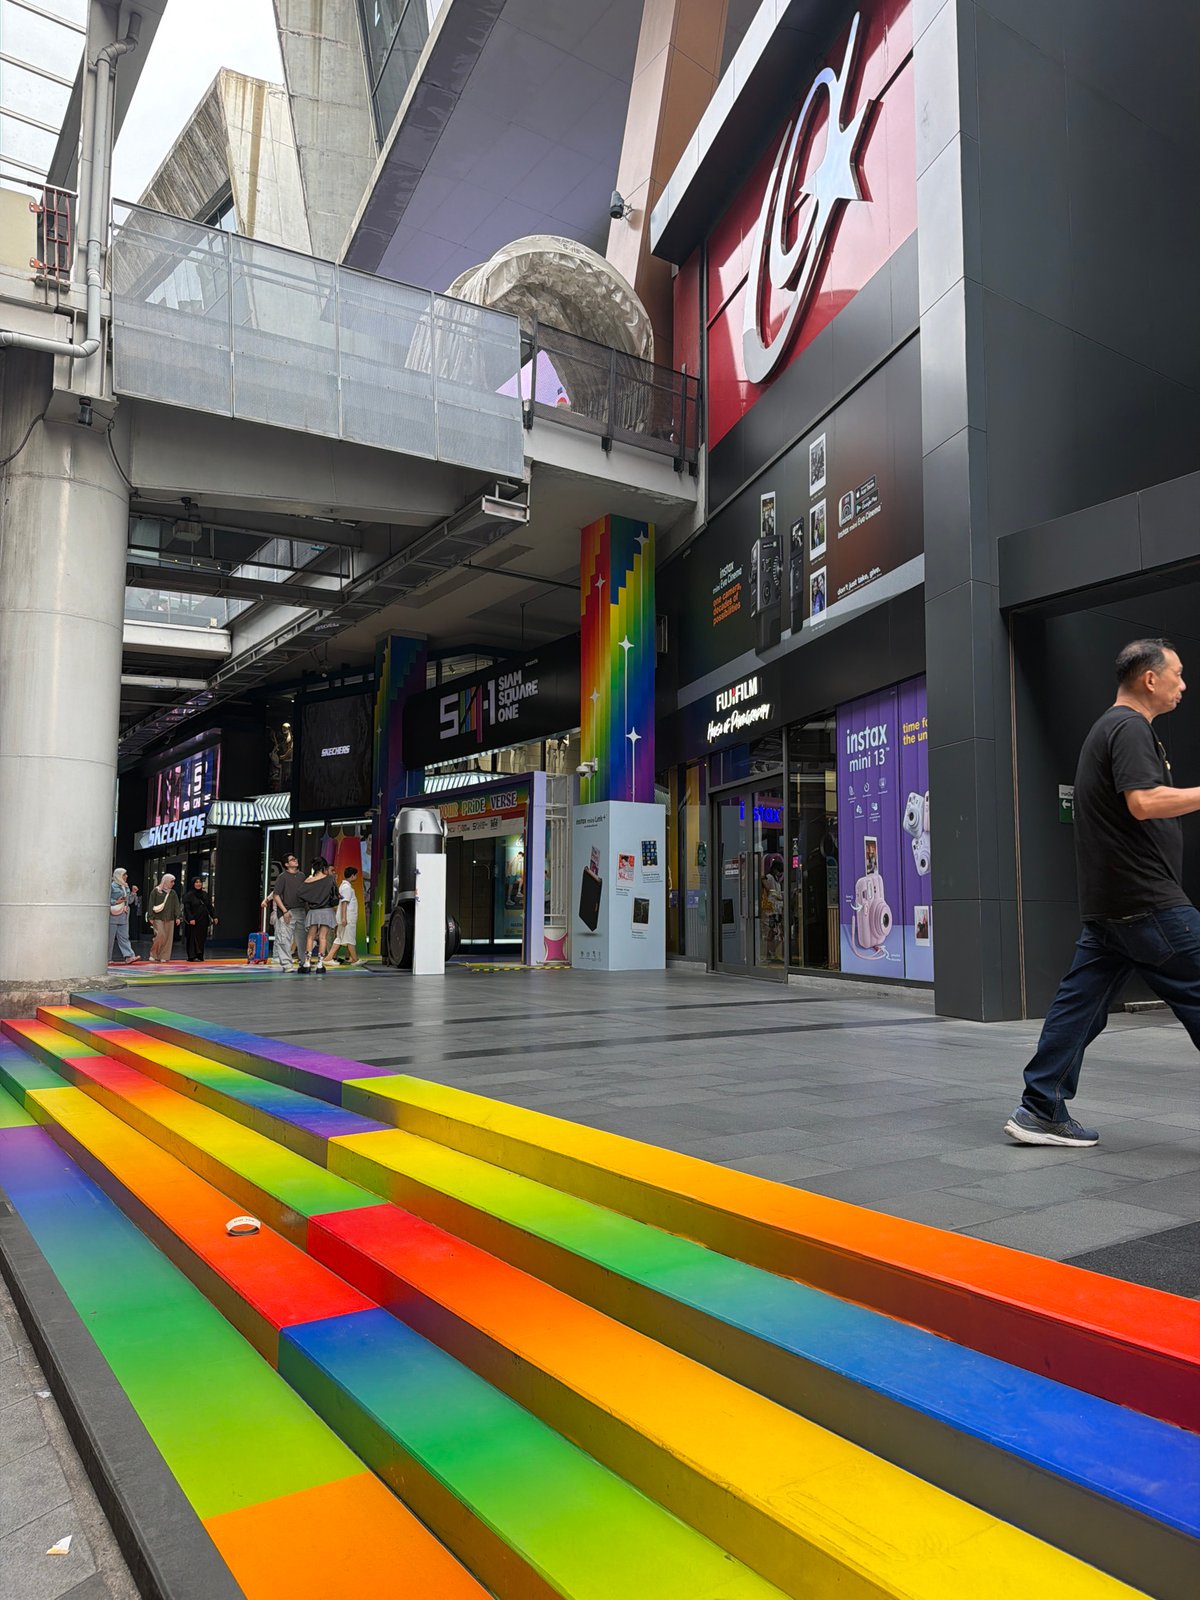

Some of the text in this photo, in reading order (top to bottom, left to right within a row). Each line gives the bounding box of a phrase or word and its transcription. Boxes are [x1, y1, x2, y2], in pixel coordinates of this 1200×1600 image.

[498, 669, 522, 691] SIAM
[498, 679, 539, 707] SQUARE
[716, 676, 758, 713] FUJIFILM
[497, 703, 519, 723] ONE
[846, 723, 888, 755] instax
[902, 722, 920, 734] time
[902, 734, 917, 746] the
[849, 753, 871, 773] mini
[490, 790, 517, 812] VERSE
[148, 812, 206, 847] SKECHERS
